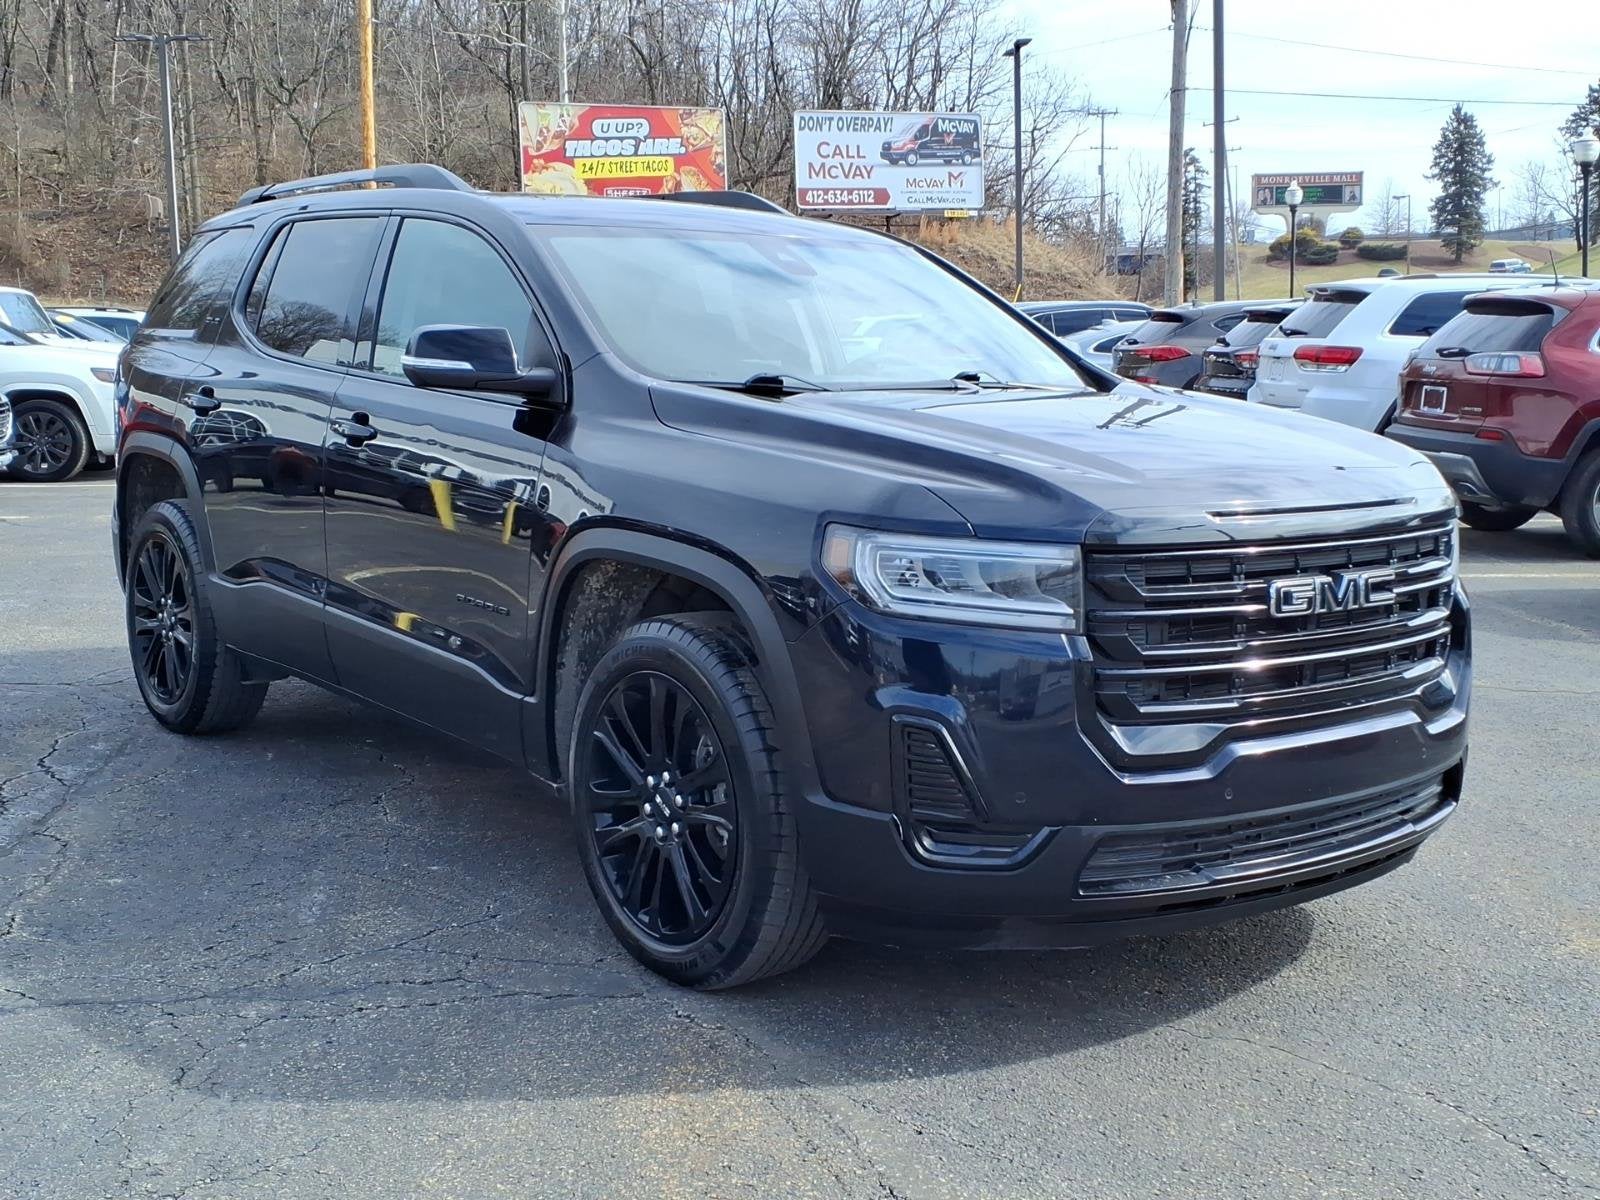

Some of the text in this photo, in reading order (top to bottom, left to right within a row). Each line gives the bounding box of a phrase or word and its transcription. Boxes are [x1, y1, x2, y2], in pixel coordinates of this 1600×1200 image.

[600, 122, 643, 134] U UP?
[798, 116, 894, 133] DON'T OVERPAY!
[565, 138, 686, 157] TACOS ARE.
[581, 159, 669, 176] 24/7 STREET TACOS
[1333, 174, 1357, 183] MALL
[806, 189, 874, 203] 412-634-6112
[1270, 573, 1396, 618] GMC
